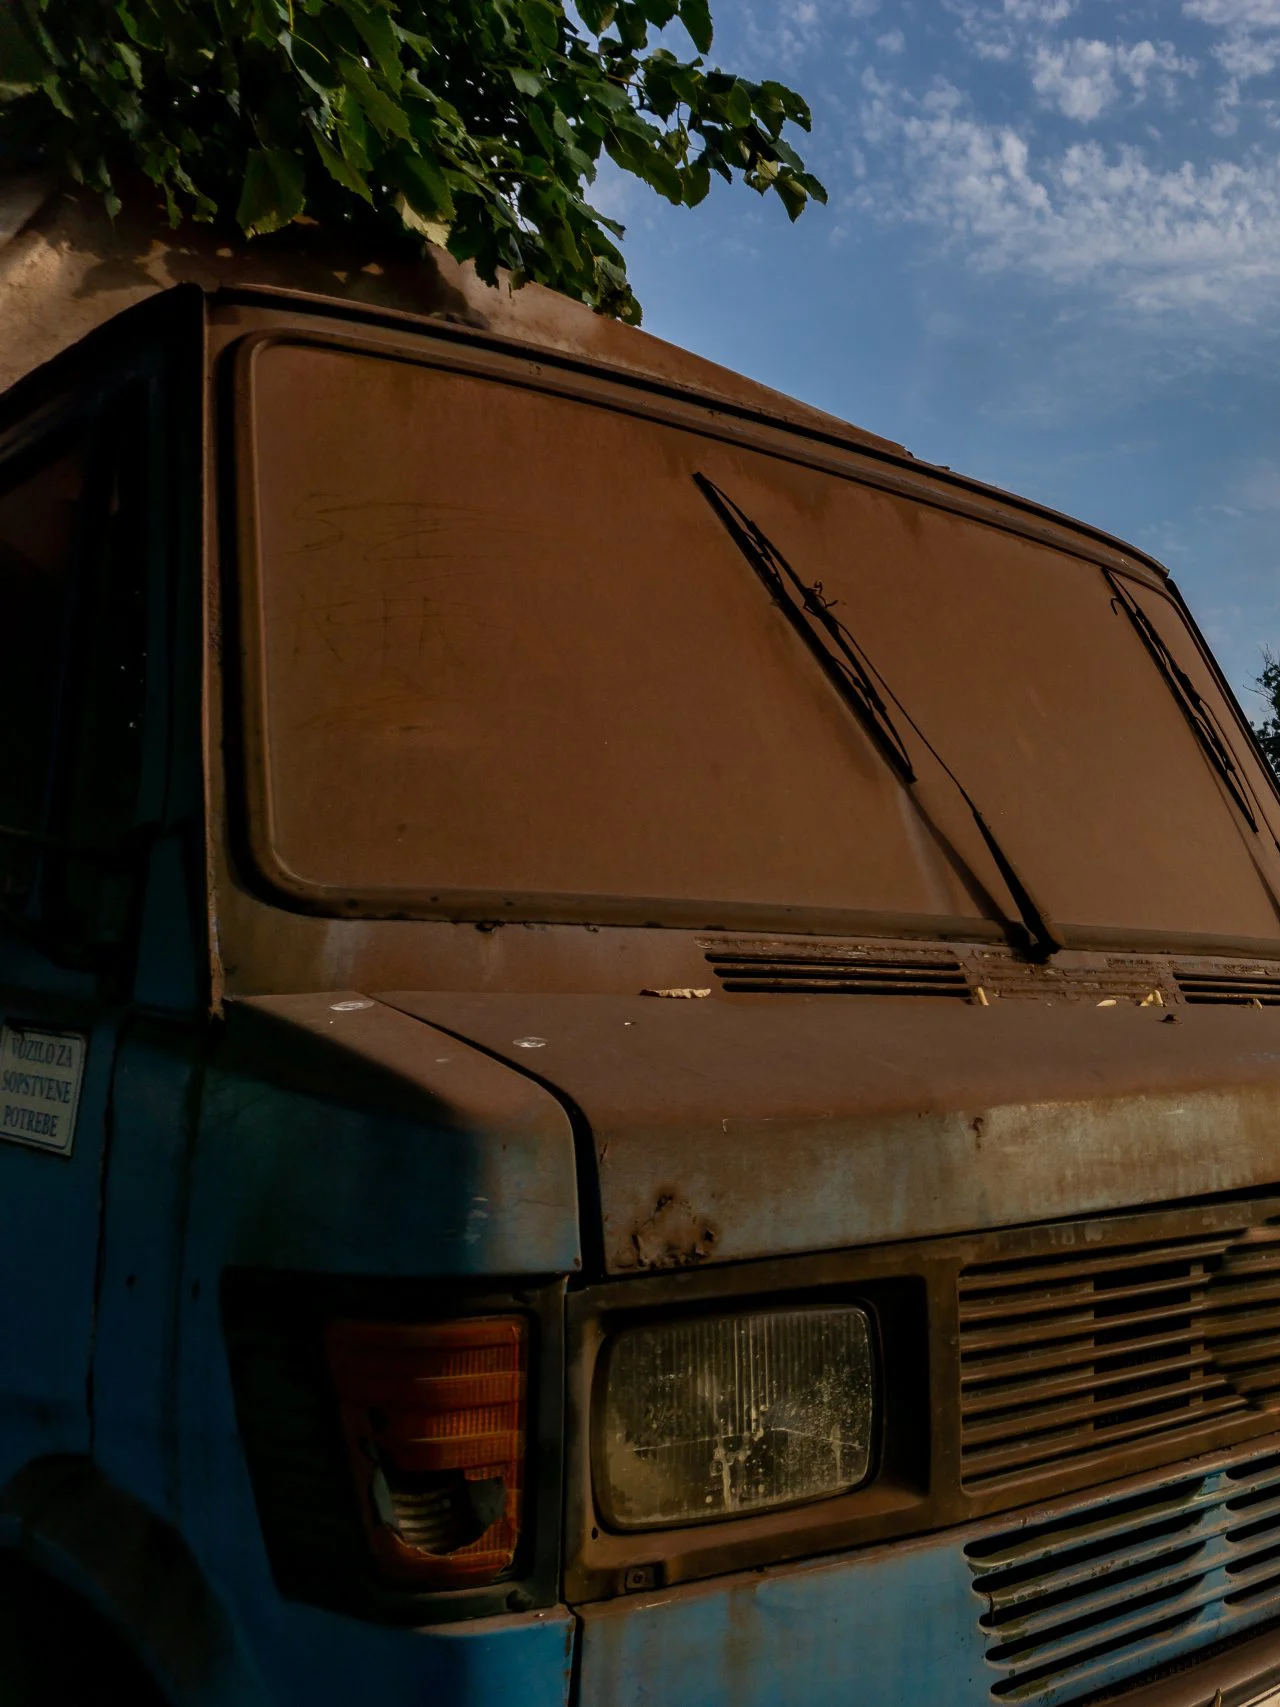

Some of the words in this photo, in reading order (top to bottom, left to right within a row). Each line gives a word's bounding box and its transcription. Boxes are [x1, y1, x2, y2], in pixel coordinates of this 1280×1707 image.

[12, 1037, 55, 1064] VOZILO
[56, 1044, 72, 1068] ZA
[2, 1070, 72, 1103] SOPSTVENE
[3, 1105, 59, 1136] POTREBE
